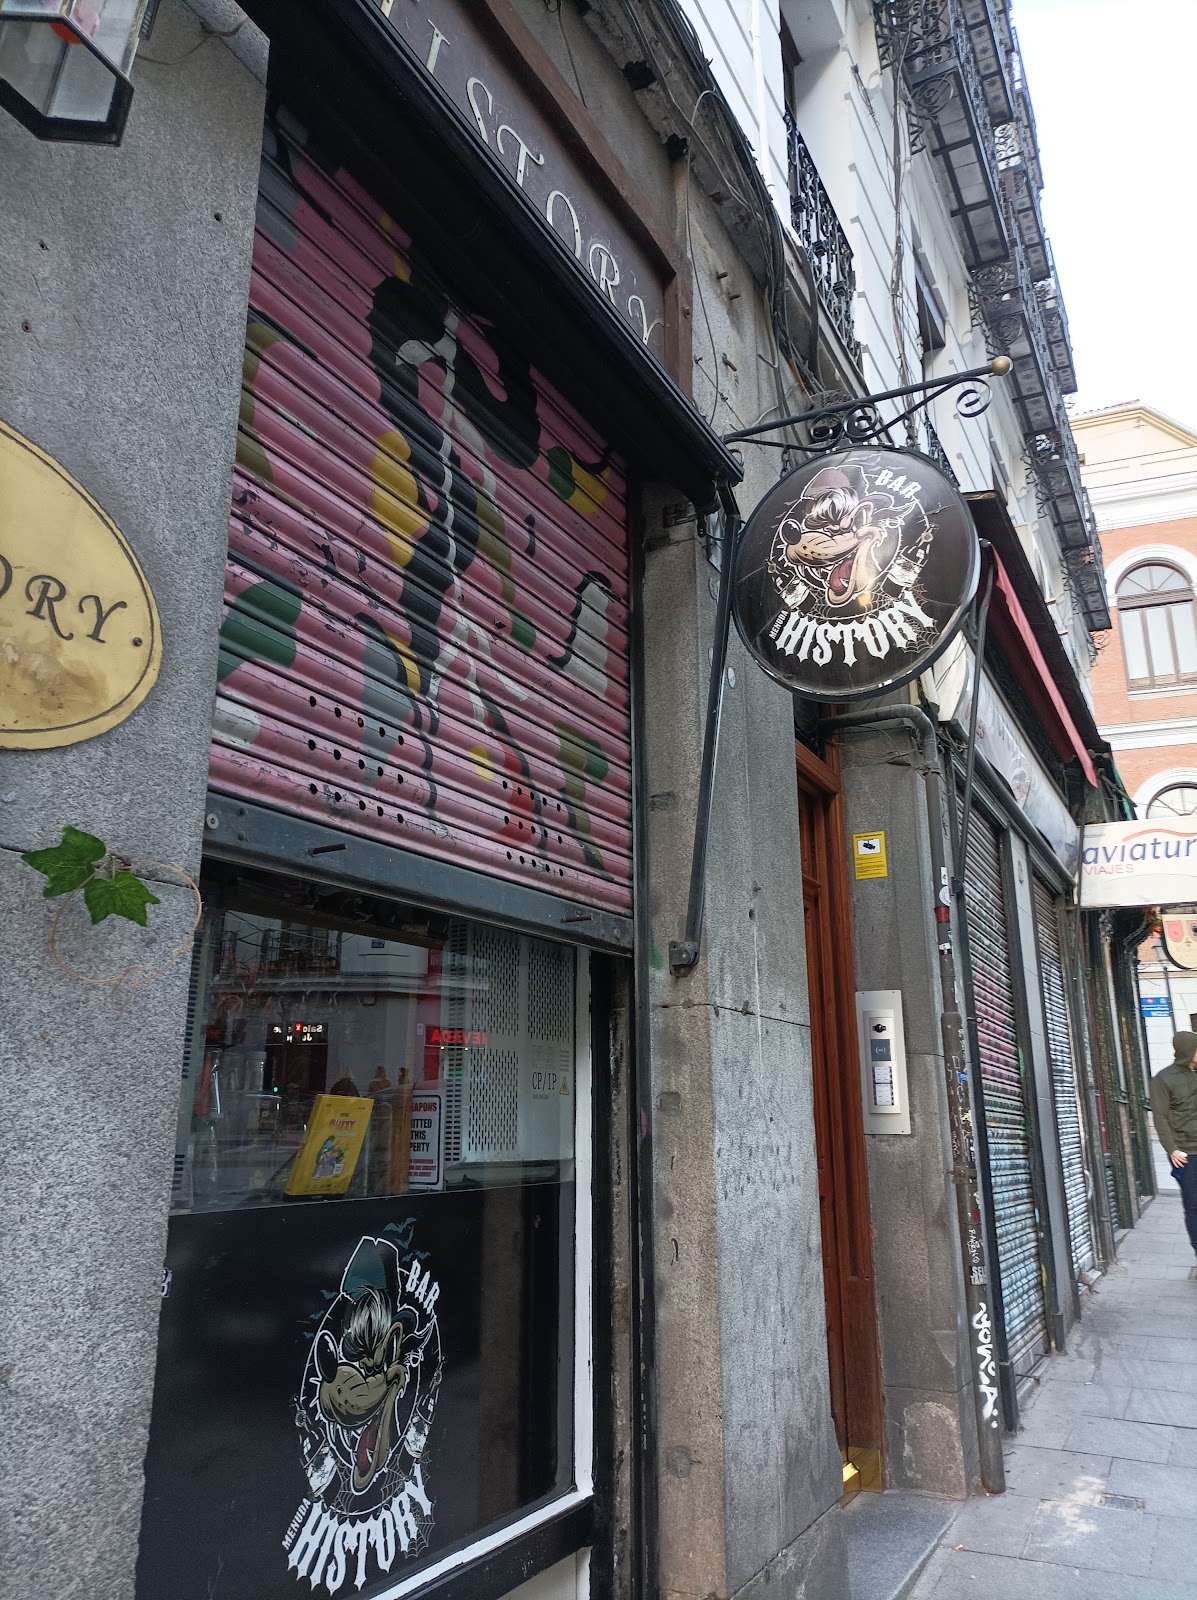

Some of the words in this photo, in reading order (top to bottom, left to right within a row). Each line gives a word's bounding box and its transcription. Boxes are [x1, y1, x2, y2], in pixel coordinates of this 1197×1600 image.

[874, 468, 922, 499] BAR
[769, 609, 789, 640] MENUDA
[775, 590, 938, 667] HISTORY
[1082, 837, 1197, 865] aviatur
[1084, 864, 1134, 876] VIAJES
[411, 1102, 437, 1112] EAPONS
[405, 1258, 440, 1315] BAR
[281, 1497, 312, 1550] MENUDA
[287, 1461, 433, 1597] HISTORY
